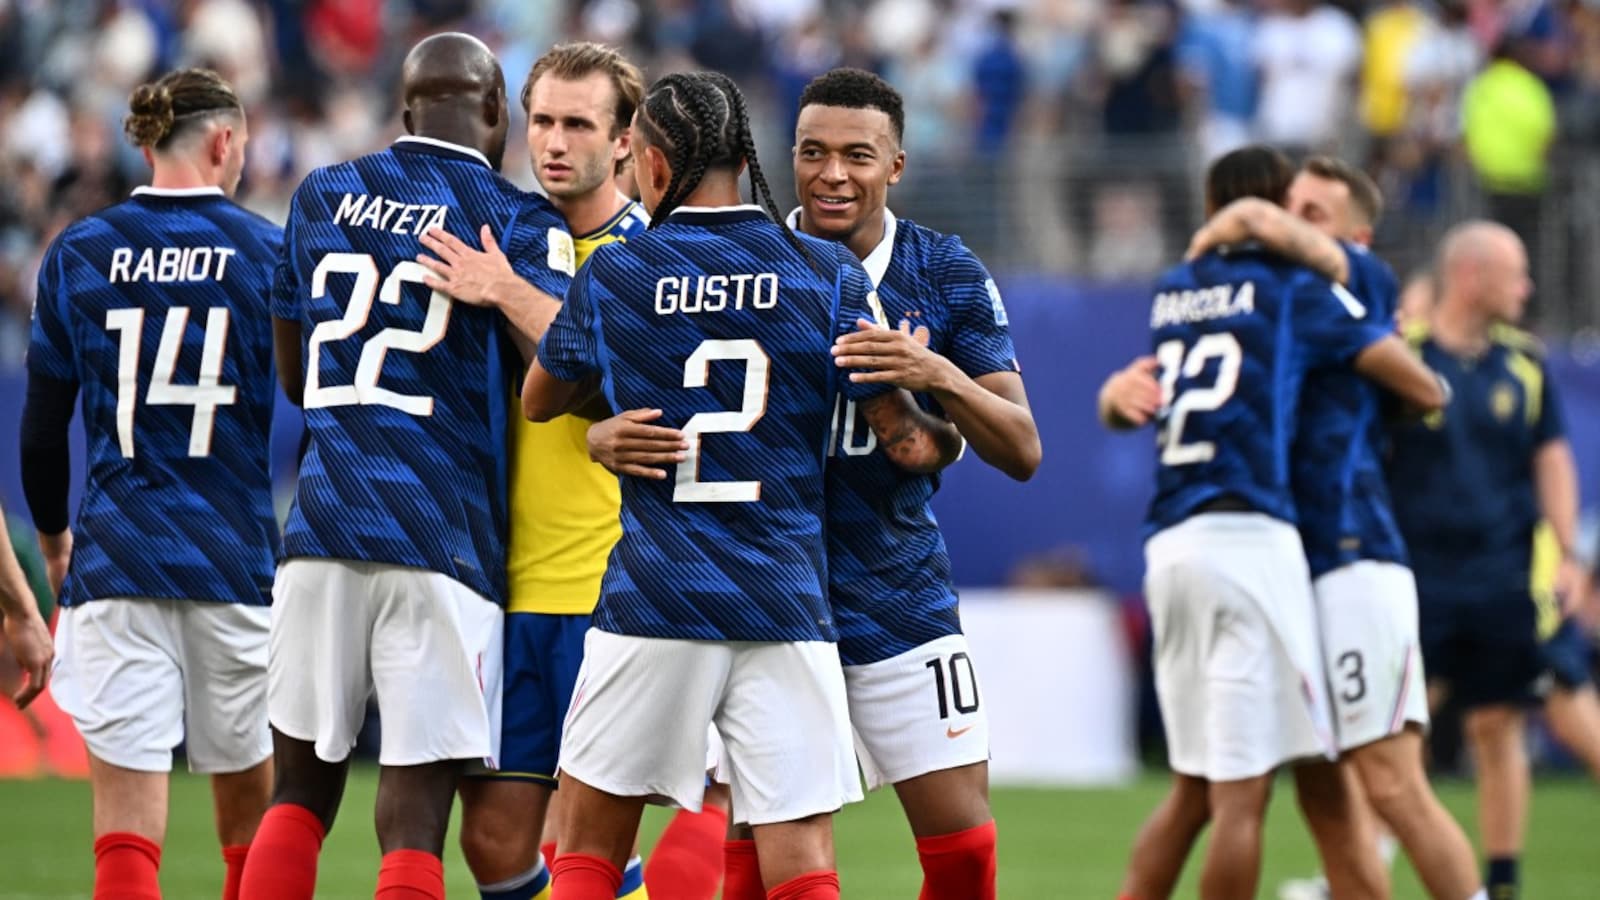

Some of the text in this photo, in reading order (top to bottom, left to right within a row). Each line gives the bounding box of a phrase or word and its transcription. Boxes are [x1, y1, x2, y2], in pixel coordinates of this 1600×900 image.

[332, 193, 449, 236] MATETA
[109, 247, 236, 283] RABIOT
[654, 273, 779, 315] GUSTO
[303, 252, 453, 417] 22
[1150, 281, 1255, 329] BARCOLA
[105, 306, 238, 459] 14
[1157, 332, 1243, 467] 12
[672, 338, 772, 503] 2
[925, 652, 980, 720] 10
[1337, 650, 1367, 705] 3
